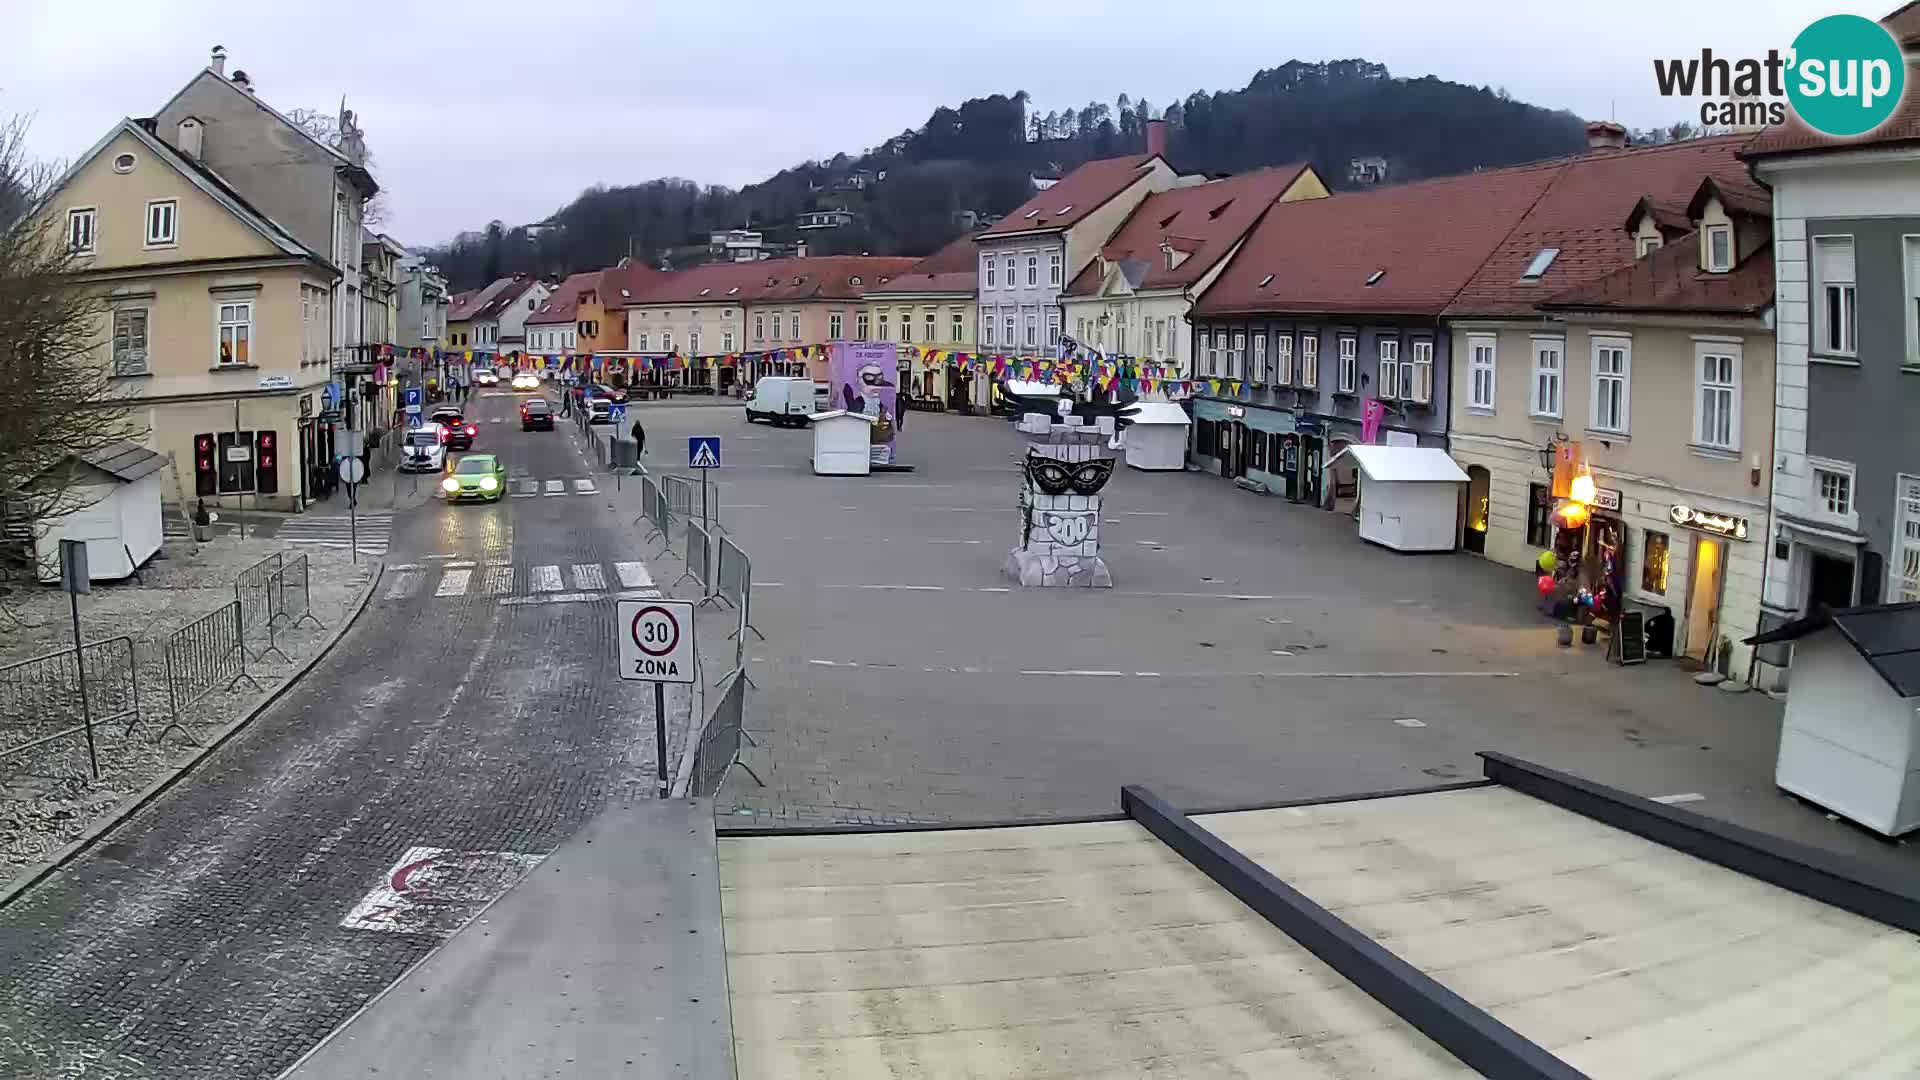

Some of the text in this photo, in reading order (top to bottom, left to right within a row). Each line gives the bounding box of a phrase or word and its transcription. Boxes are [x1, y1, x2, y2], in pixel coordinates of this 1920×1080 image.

[409, 391, 417, 403] P
[1048, 516, 1087, 545] 200
[644, 622, 668, 643] 30
[635, 659, 678, 676] ZONA
